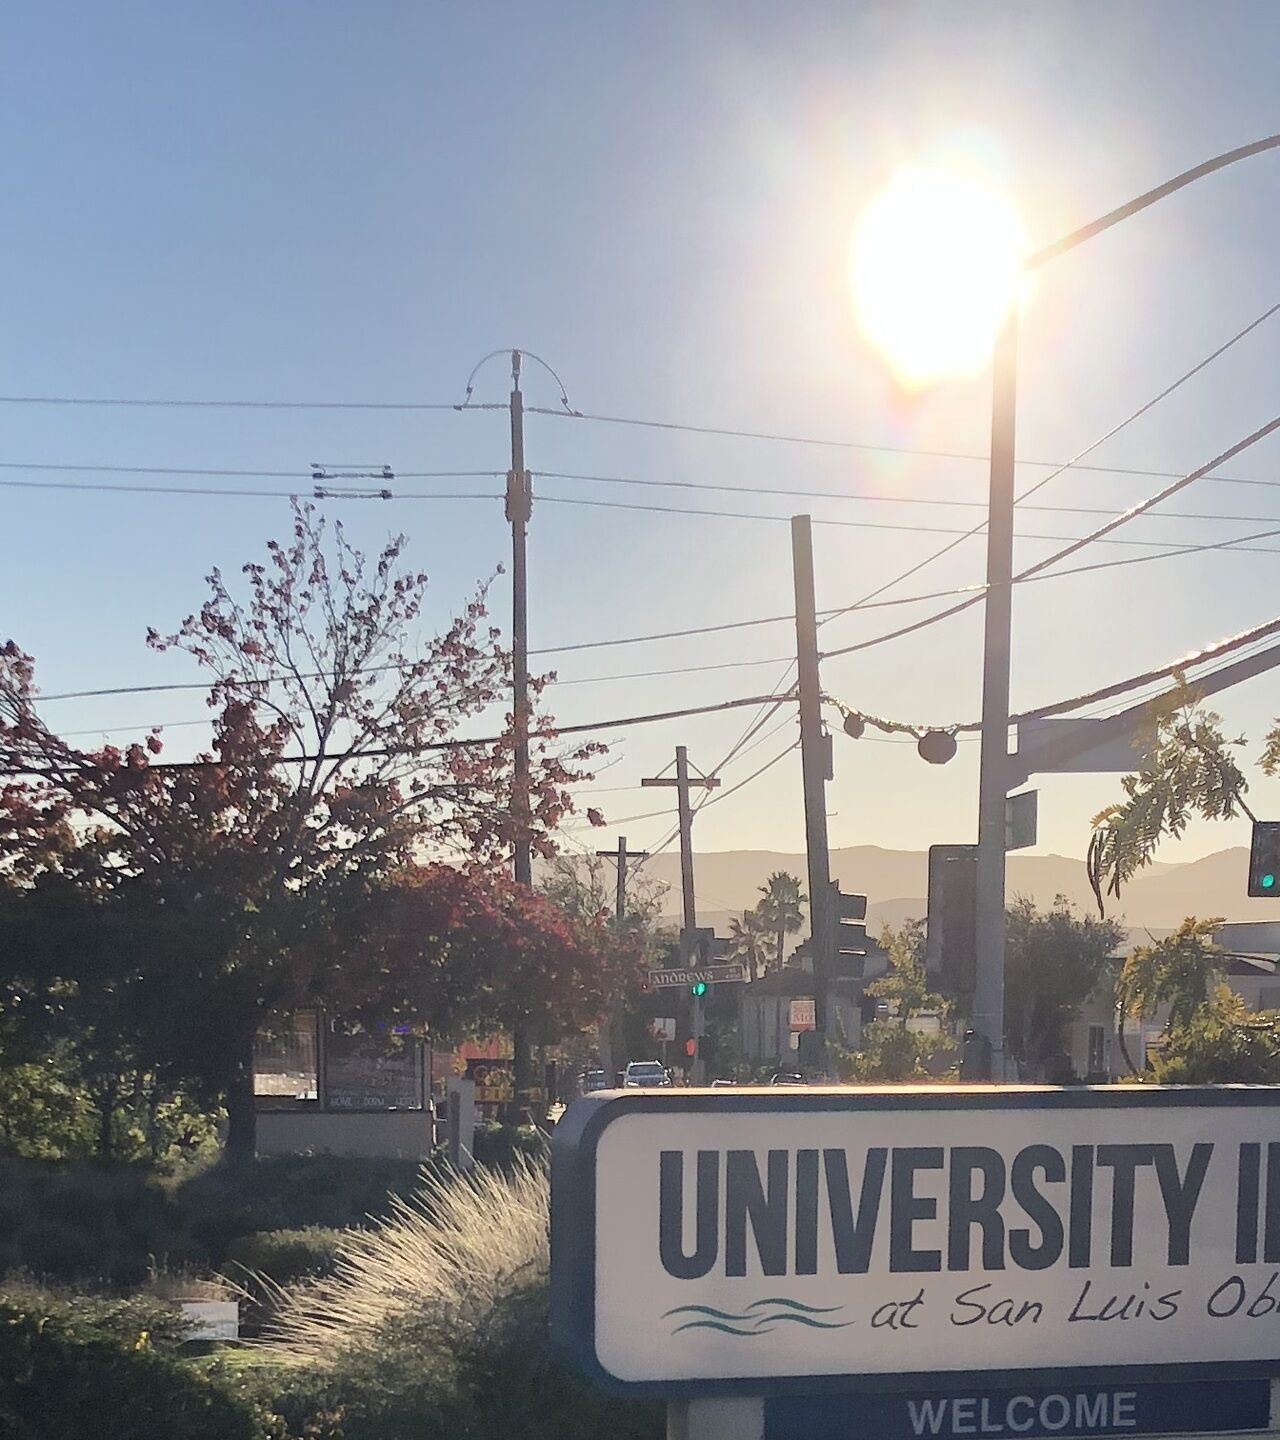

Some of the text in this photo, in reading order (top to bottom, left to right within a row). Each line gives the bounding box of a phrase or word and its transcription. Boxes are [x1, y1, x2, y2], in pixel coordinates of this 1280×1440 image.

[653, 971, 714, 984] ANDREWS
[660, 1143, 1215, 1280] UNIVERSITY
[871, 1288, 925, 1330] at
[950, 1283, 1043, 1326] San
[1067, 1280, 1183, 1322] Luis
[907, 1391, 1137, 1435] WELCOME
